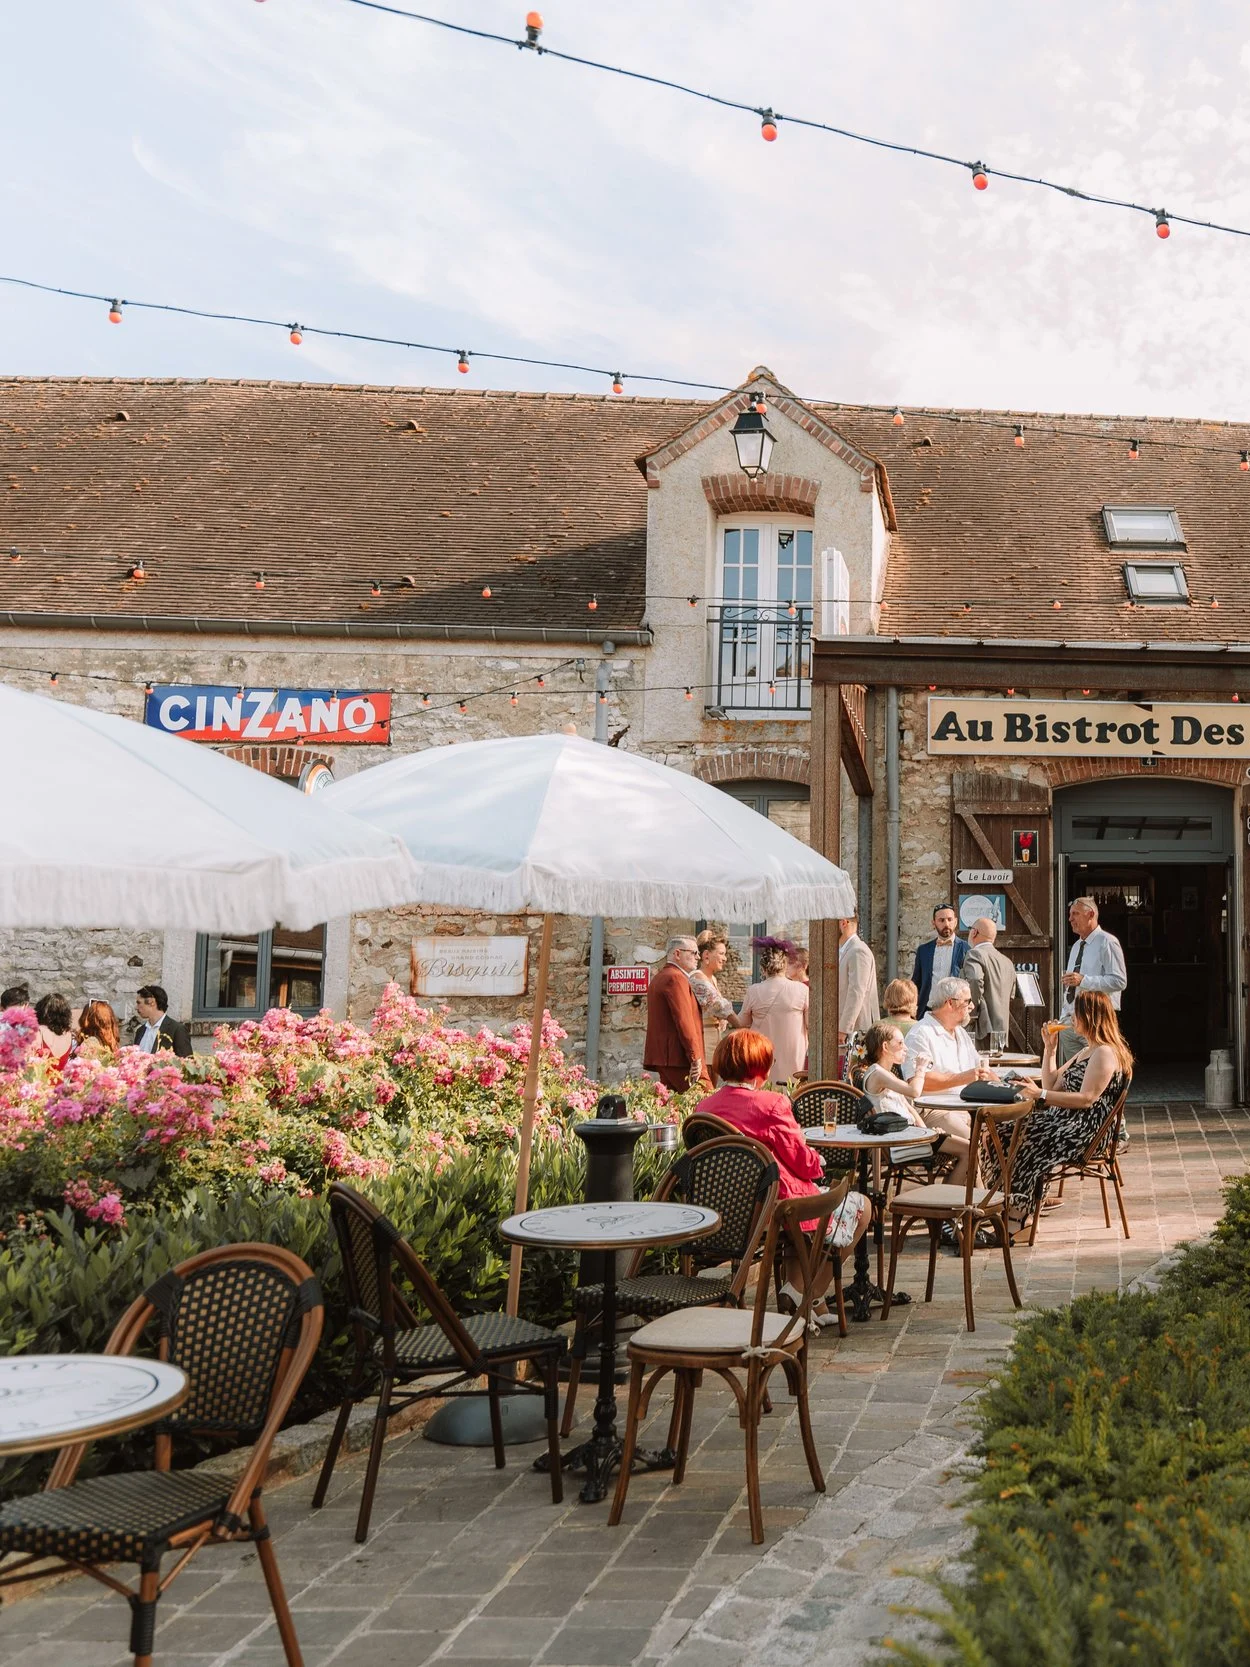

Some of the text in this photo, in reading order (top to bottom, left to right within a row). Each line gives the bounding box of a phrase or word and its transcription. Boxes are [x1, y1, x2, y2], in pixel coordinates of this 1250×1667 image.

[159, 691, 376, 738] CINZANO
[932, 711, 994, 742] Au
[1003, 713, 1160, 745] Bistrot
[1170, 716, 1244, 746] Des
[1146, 757, 1152, 766] 4
[969, 873, 1010, 881] Le Lavoir
[416, 959, 524, 982] Bisquit
[611, 969, 645, 979] ABSINTHE
[609, 982, 634, 991] PREMIER
